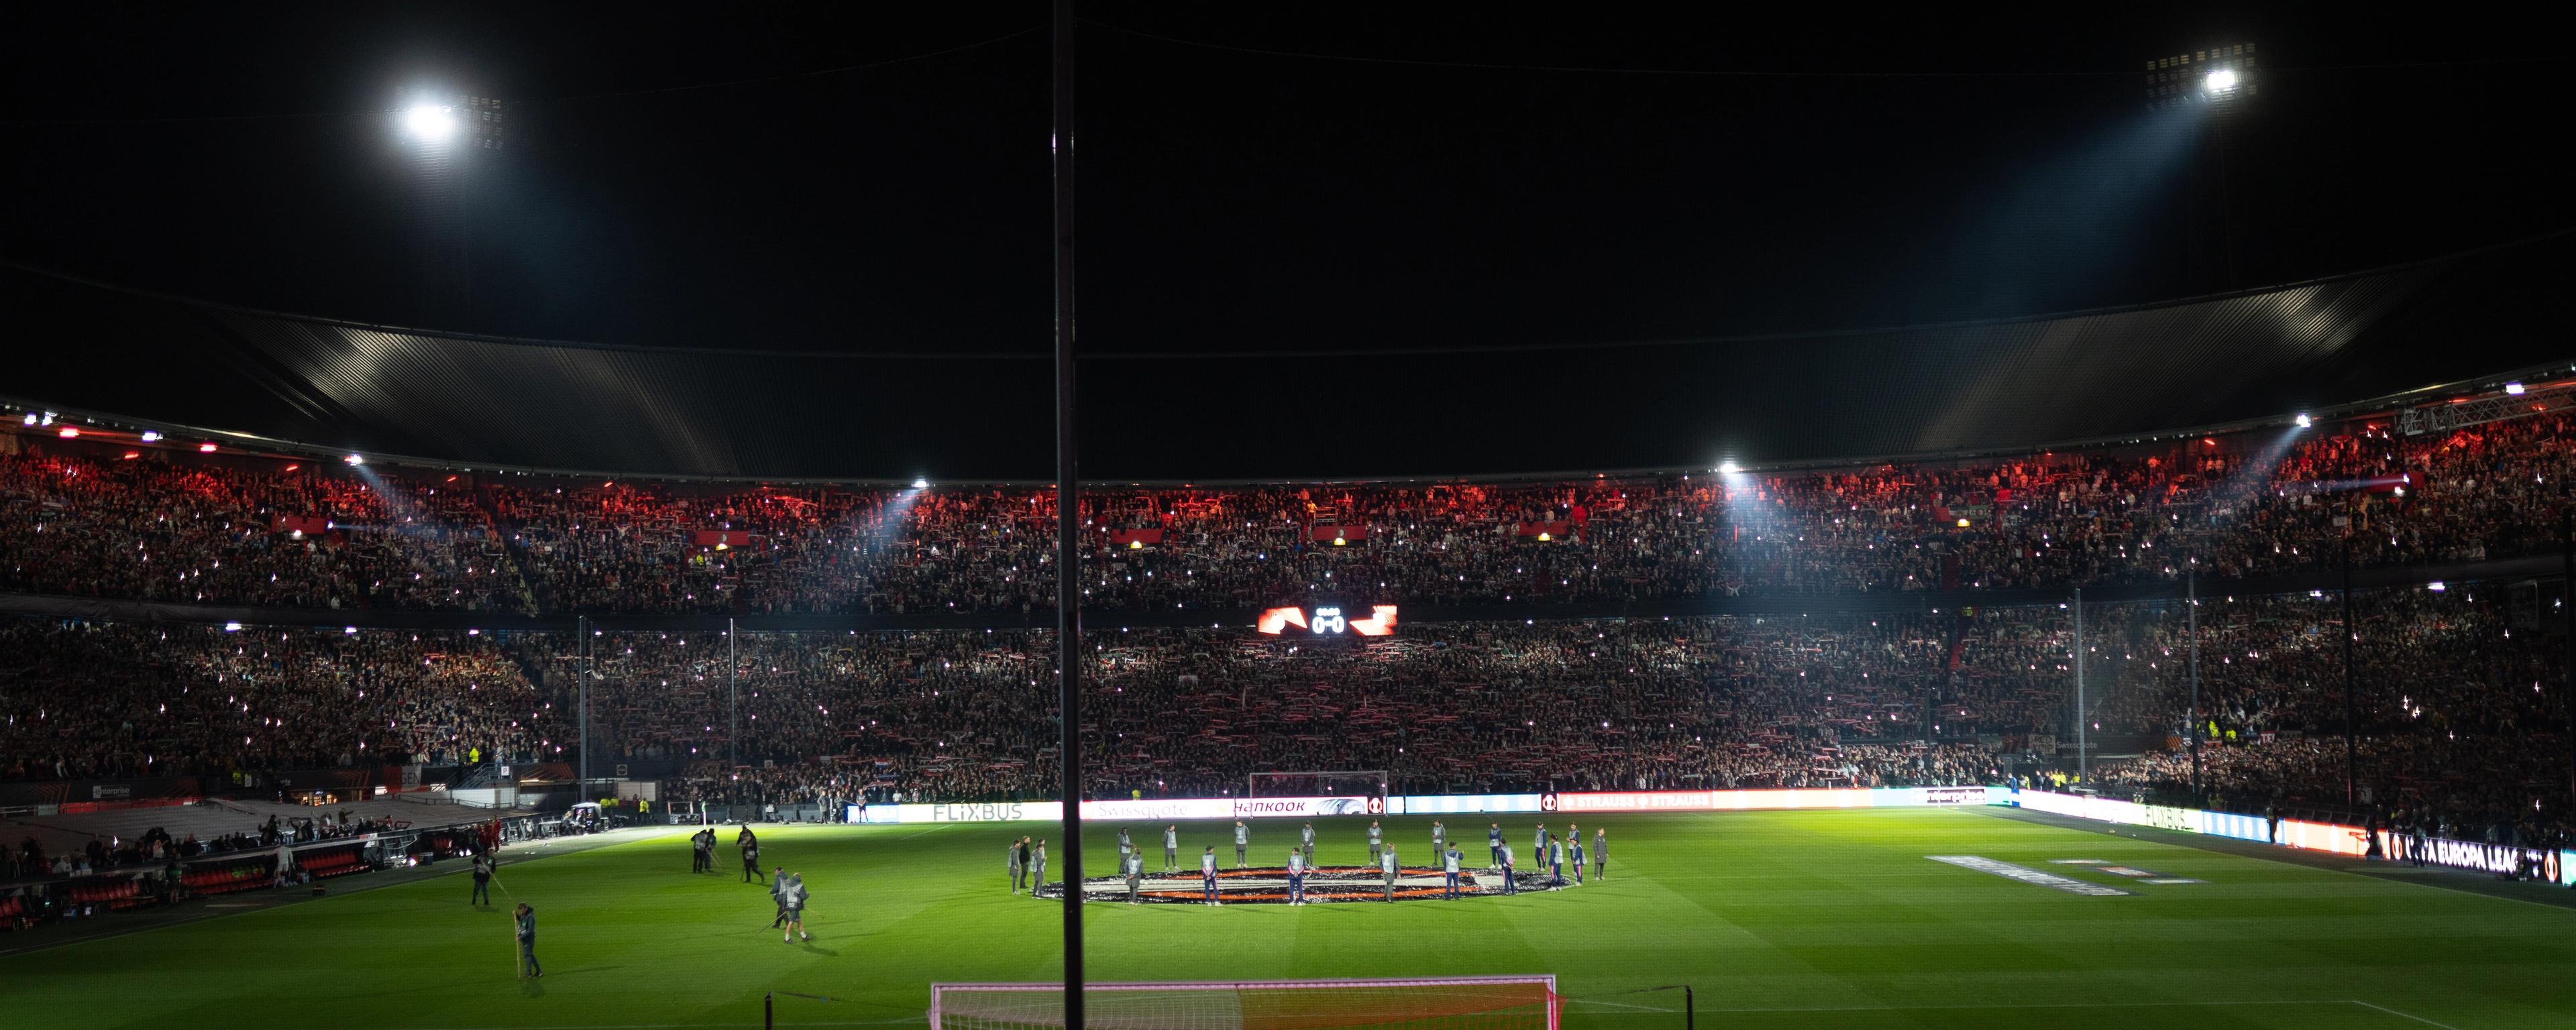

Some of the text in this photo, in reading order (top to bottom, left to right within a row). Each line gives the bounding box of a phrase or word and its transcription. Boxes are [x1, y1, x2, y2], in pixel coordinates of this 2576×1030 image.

[2057, 741, 2098, 749] Swissote
[1099, 803, 1187, 817] Swissquote
[2438, 839, 2486, 870] EUROPA
